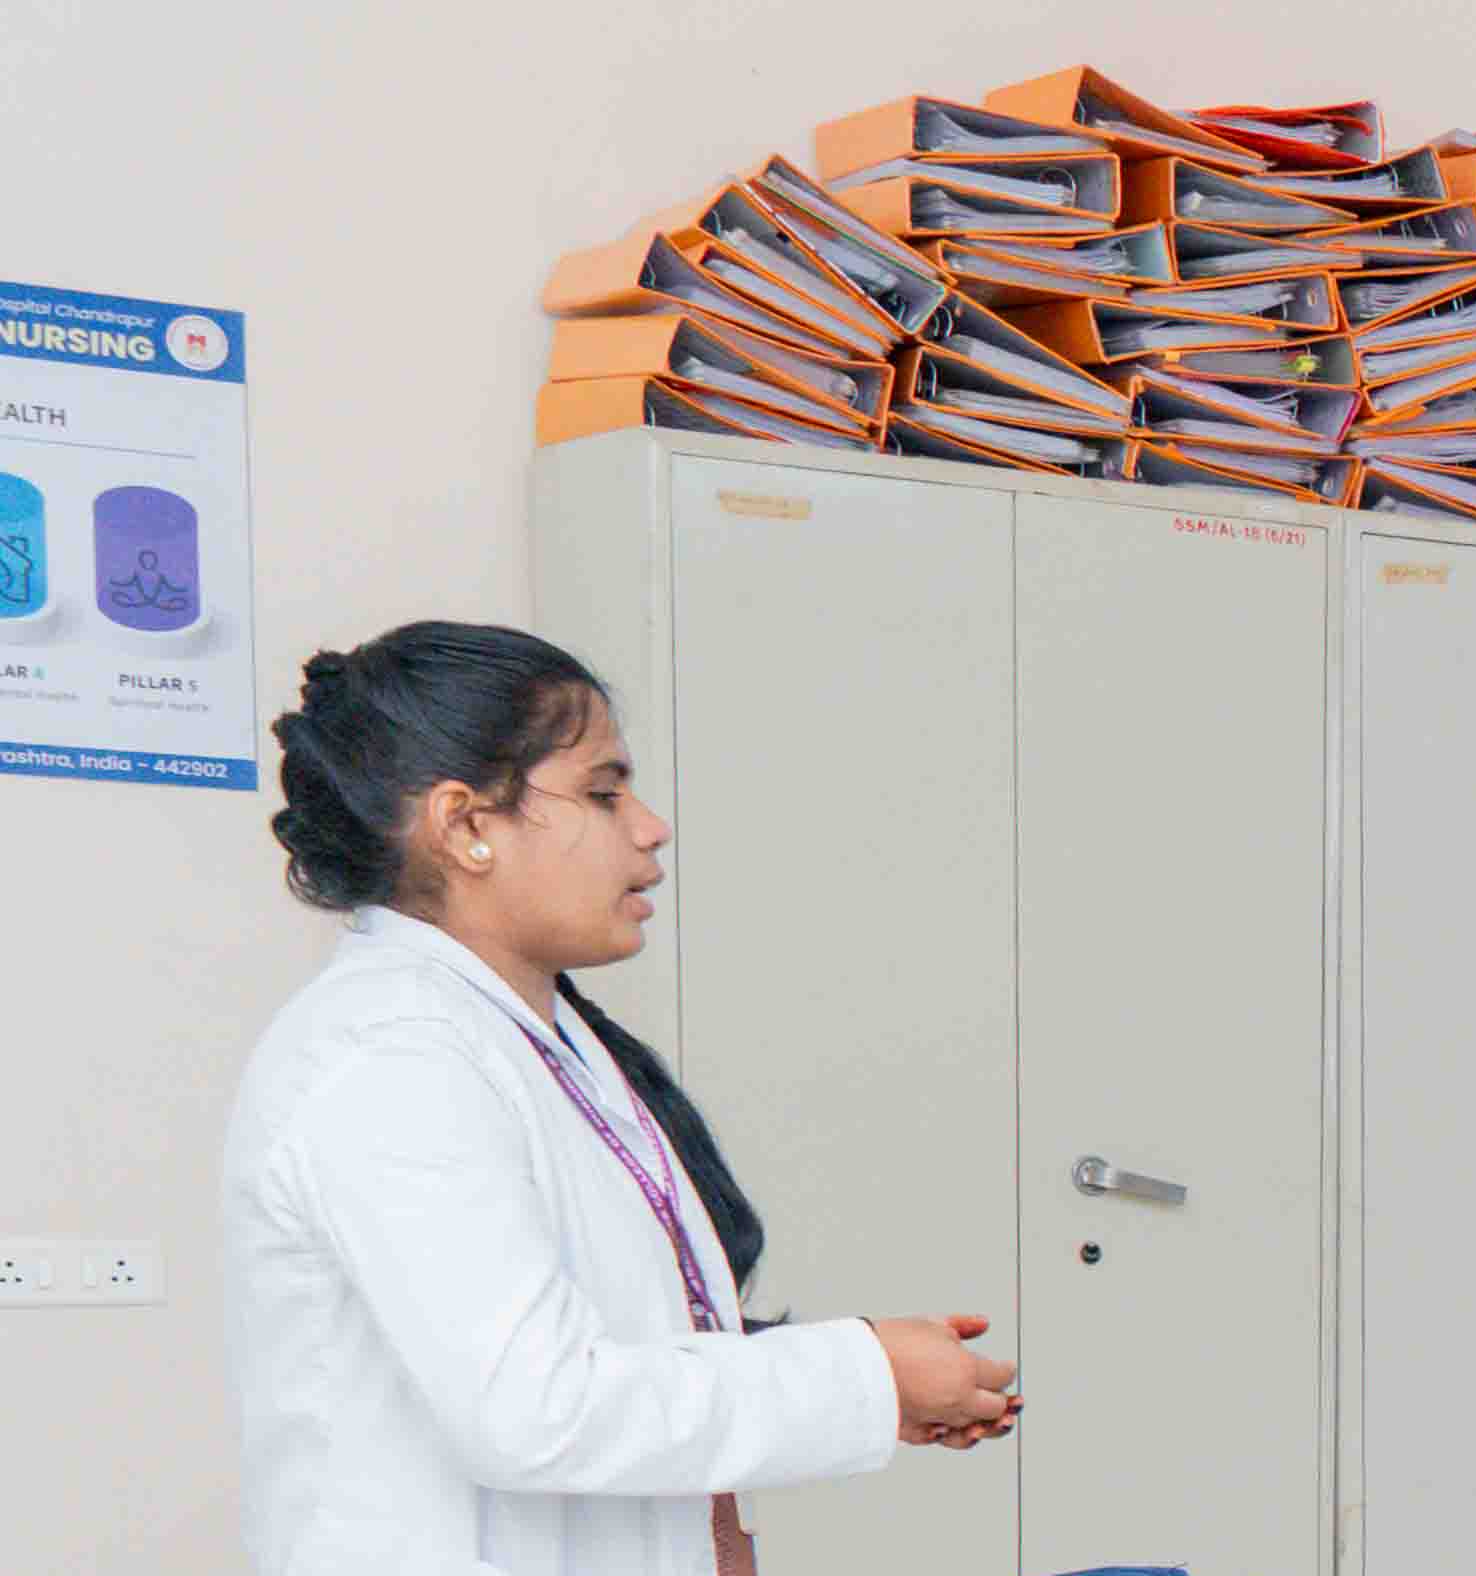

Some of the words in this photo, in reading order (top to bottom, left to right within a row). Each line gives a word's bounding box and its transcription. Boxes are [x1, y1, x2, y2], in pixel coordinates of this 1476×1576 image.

[54, 303, 157, 328] Chandrapur
[0, 319, 156, 362] NURSING
[118, 673, 183, 691] PILLAR
[80, 752, 131, 771] India
[154, 758, 228, 778] 442902
